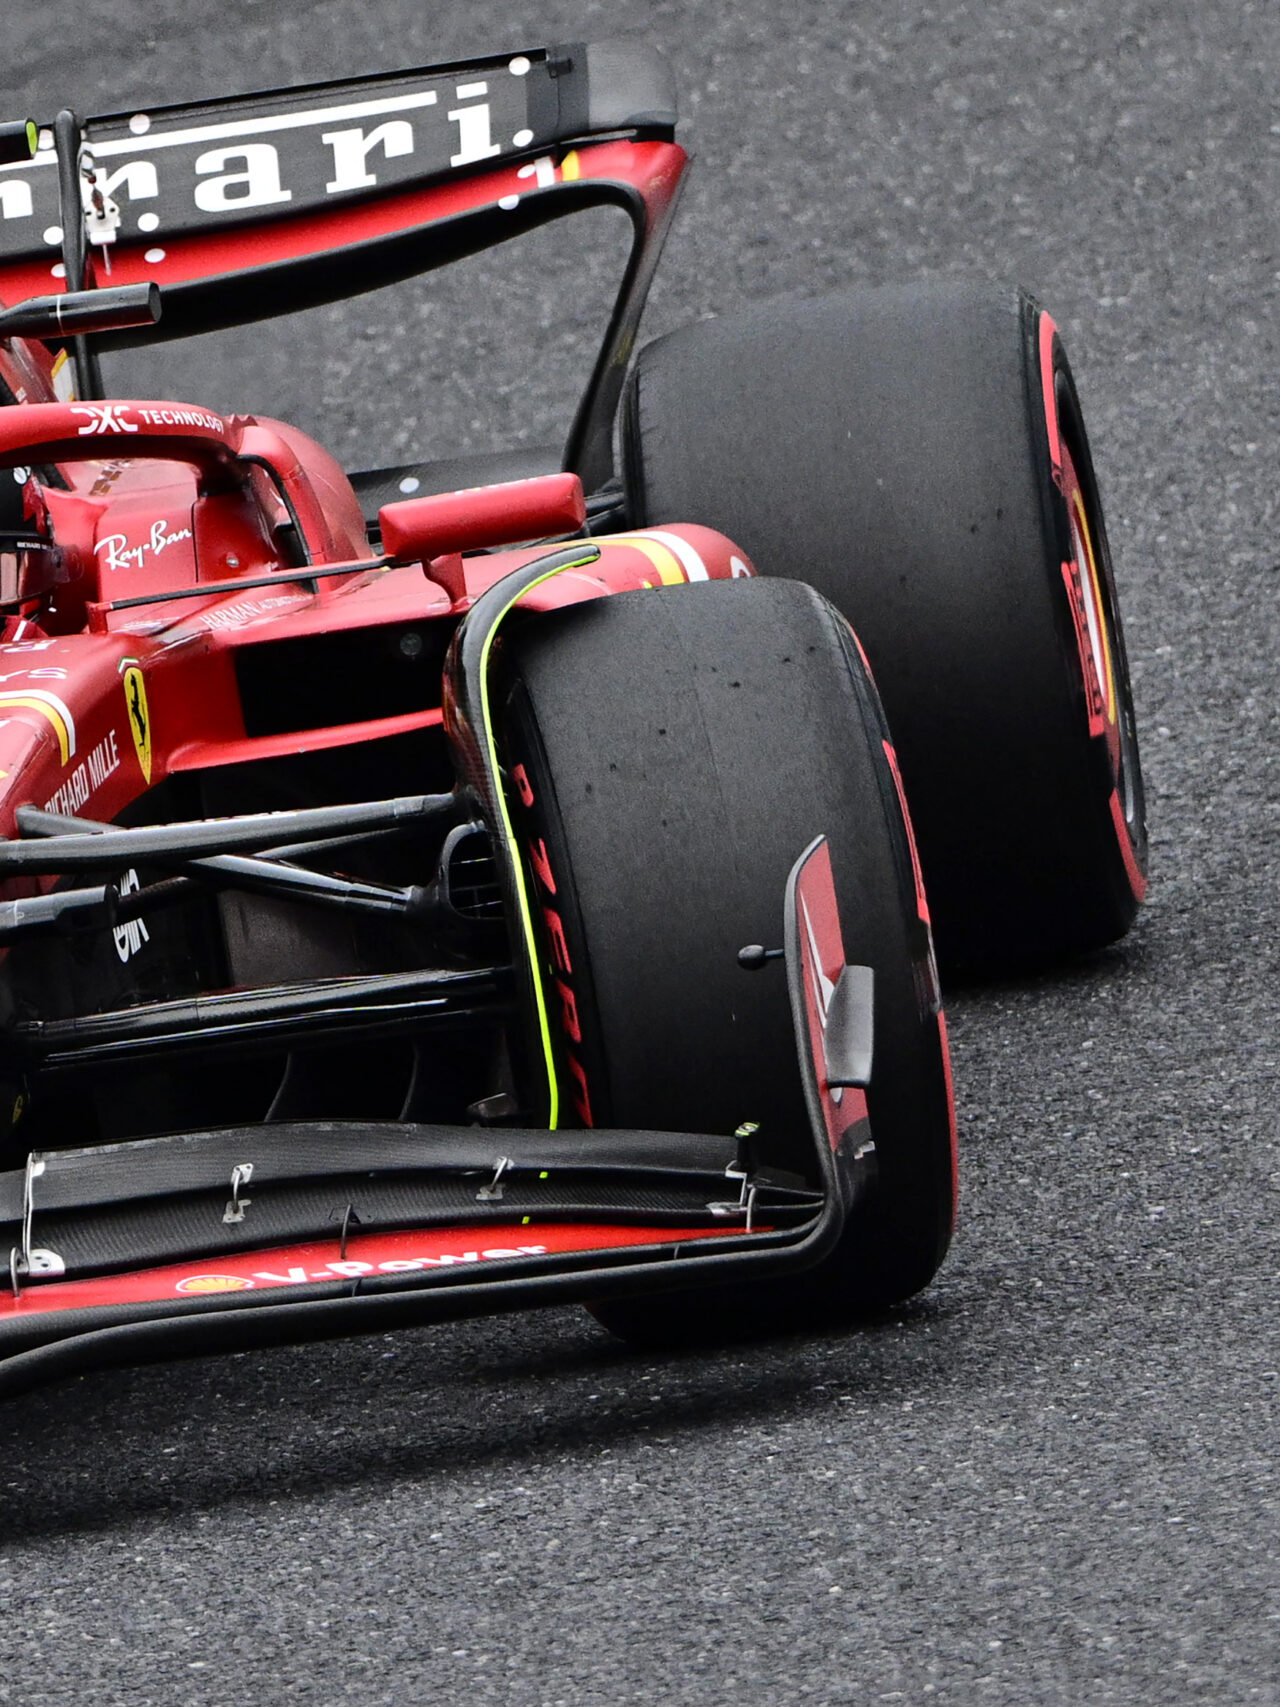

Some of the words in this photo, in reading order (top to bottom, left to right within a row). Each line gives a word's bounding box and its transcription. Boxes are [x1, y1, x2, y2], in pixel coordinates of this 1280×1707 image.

[138, 409, 224, 435] TECHNOLOGY
[93, 519, 192, 571] Ray-Ban
[87, 729, 120, 792] MILLE
[254, 1245, 549, 1283] V-Power
